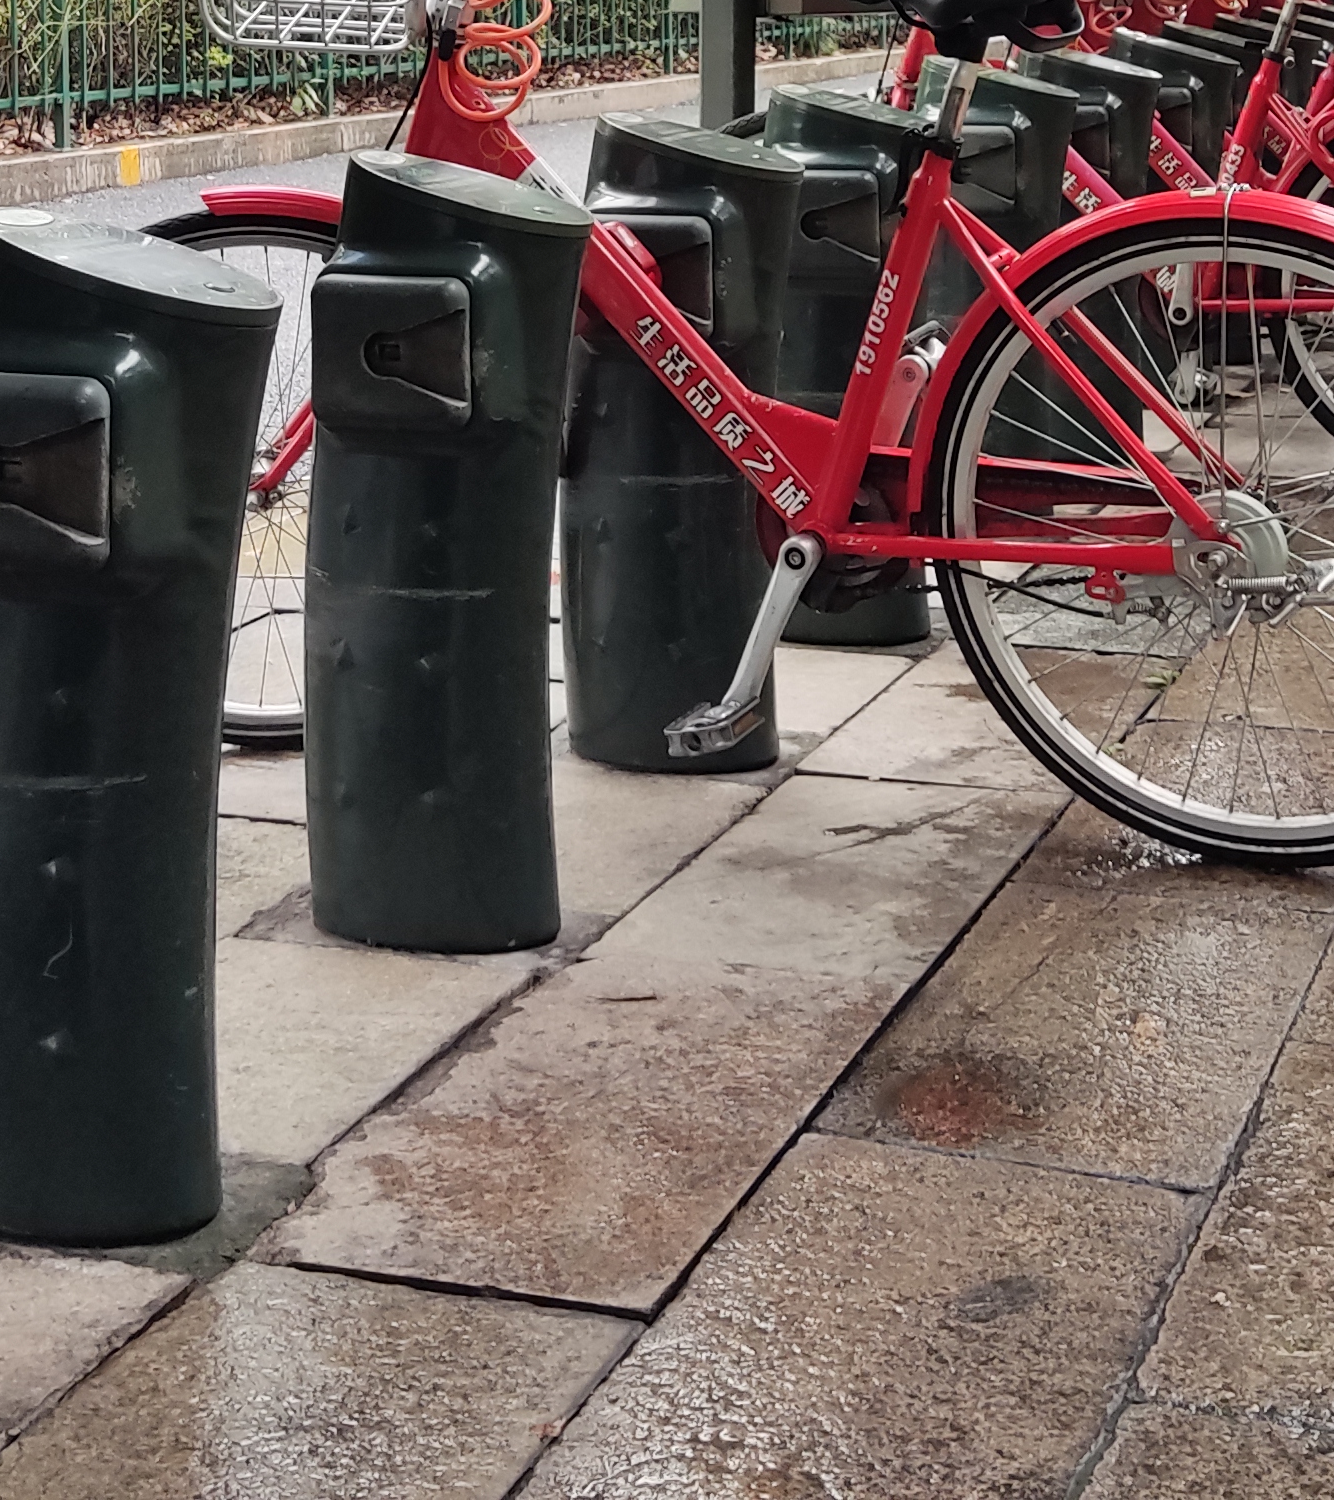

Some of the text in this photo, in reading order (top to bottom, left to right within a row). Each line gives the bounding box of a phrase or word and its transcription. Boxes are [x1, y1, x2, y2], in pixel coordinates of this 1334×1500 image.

[855, 268, 900, 376] 1910562
[630, 315, 811, 519] 生活品质之城
